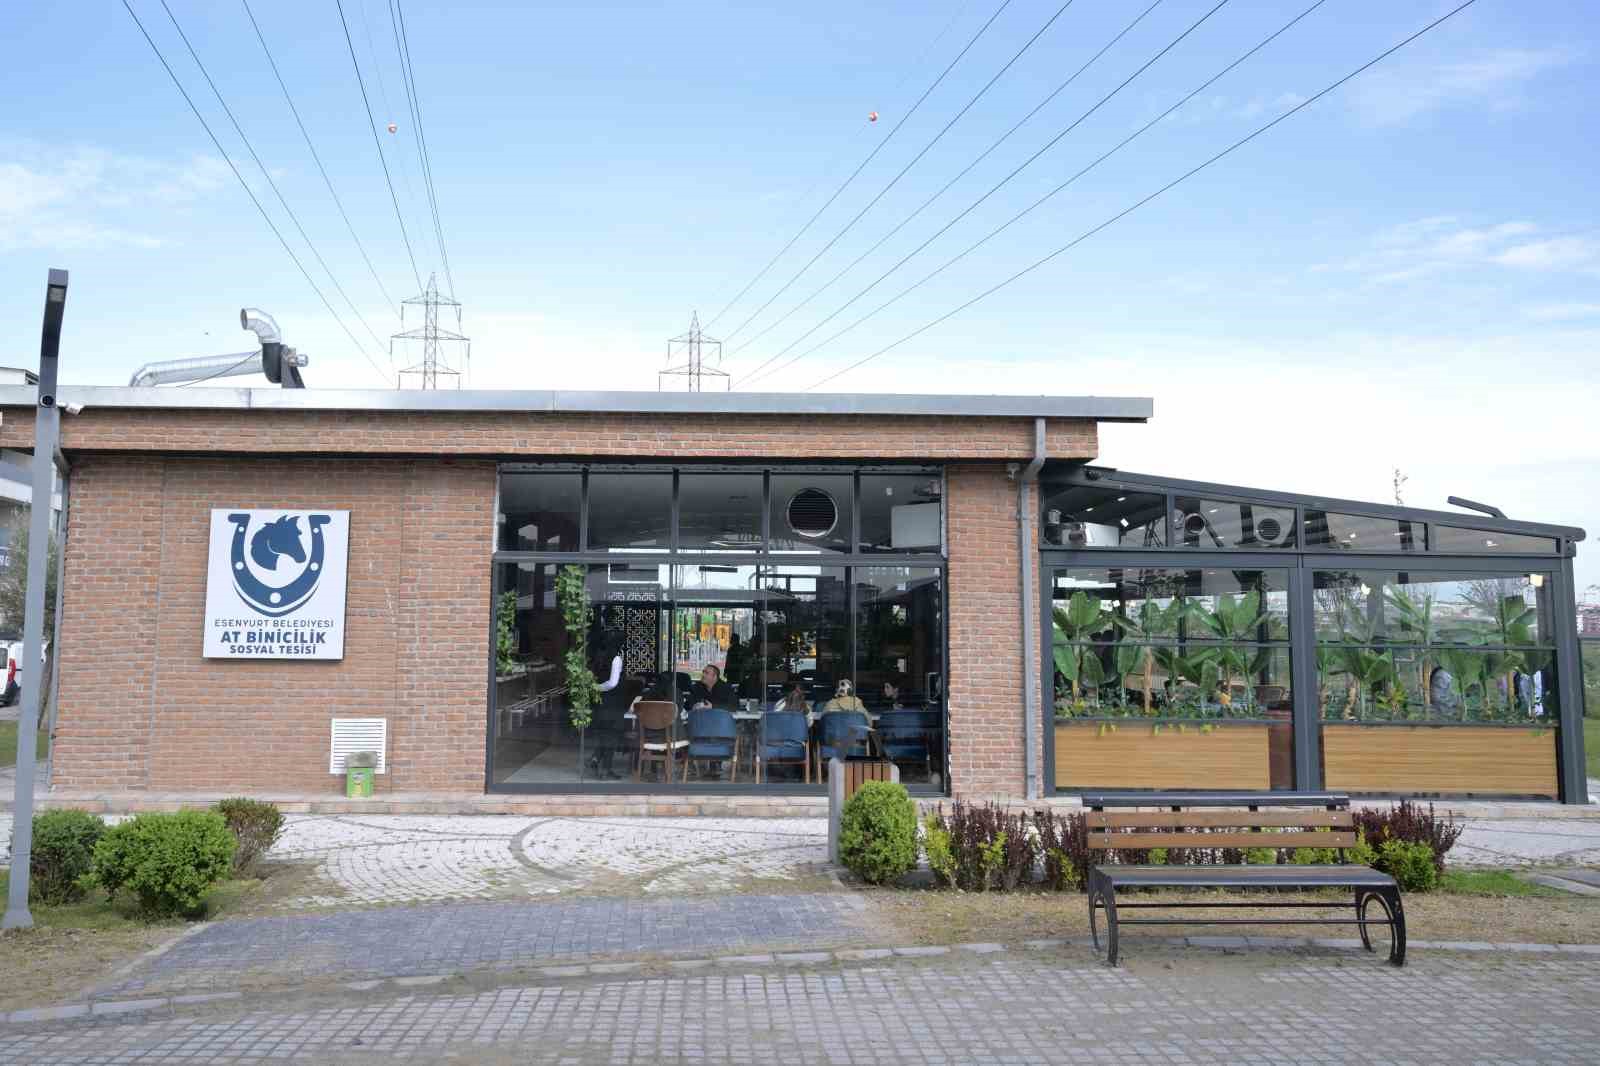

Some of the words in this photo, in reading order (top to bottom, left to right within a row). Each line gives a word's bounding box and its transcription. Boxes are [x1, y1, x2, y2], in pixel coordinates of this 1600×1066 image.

[214, 619, 269, 627] ESENYURT
[220, 631, 241, 643] AT
[246, 628, 327, 644] BİNİCİLİK
[229, 644, 275, 654] SOSYAL
[280, 643, 317, 655] TESİSİ
